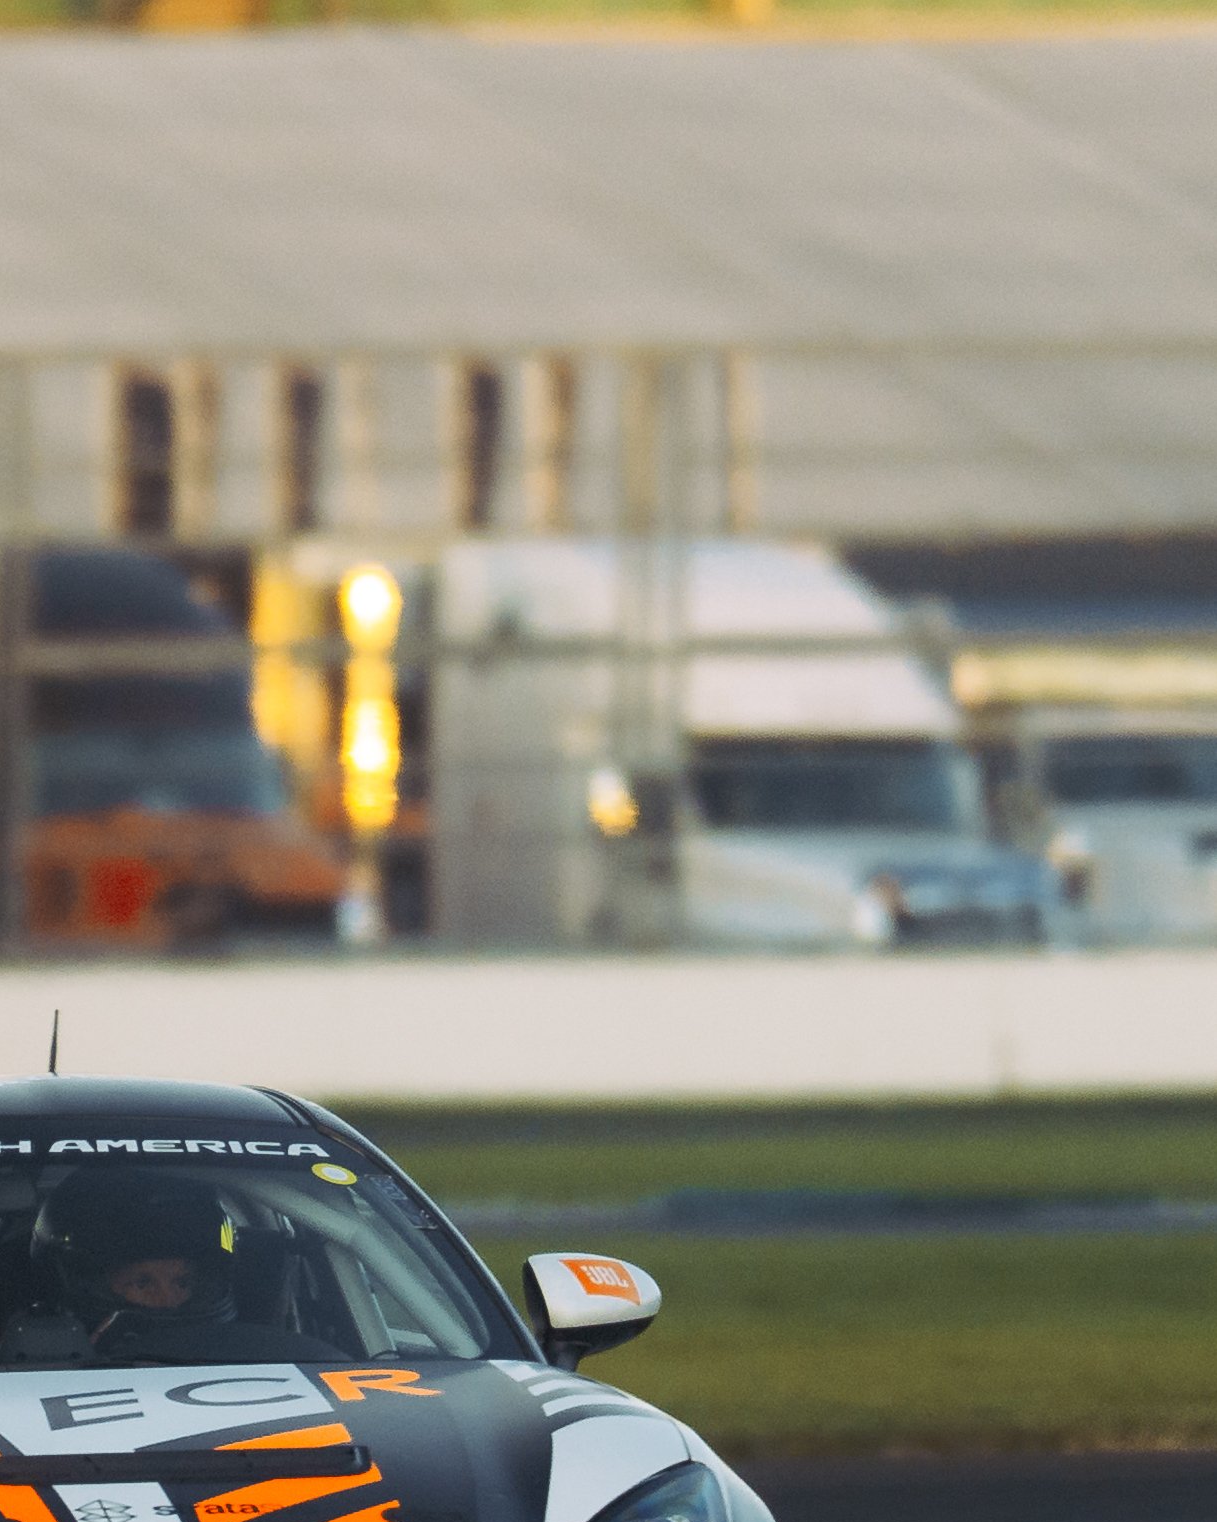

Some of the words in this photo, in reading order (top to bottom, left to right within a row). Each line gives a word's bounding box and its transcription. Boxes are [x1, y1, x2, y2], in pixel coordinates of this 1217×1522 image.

[48, 1137, 330, 1157] AMERICA
[581, 1261, 629, 1289] JBL
[39, 1369, 442, 1431] ECR
